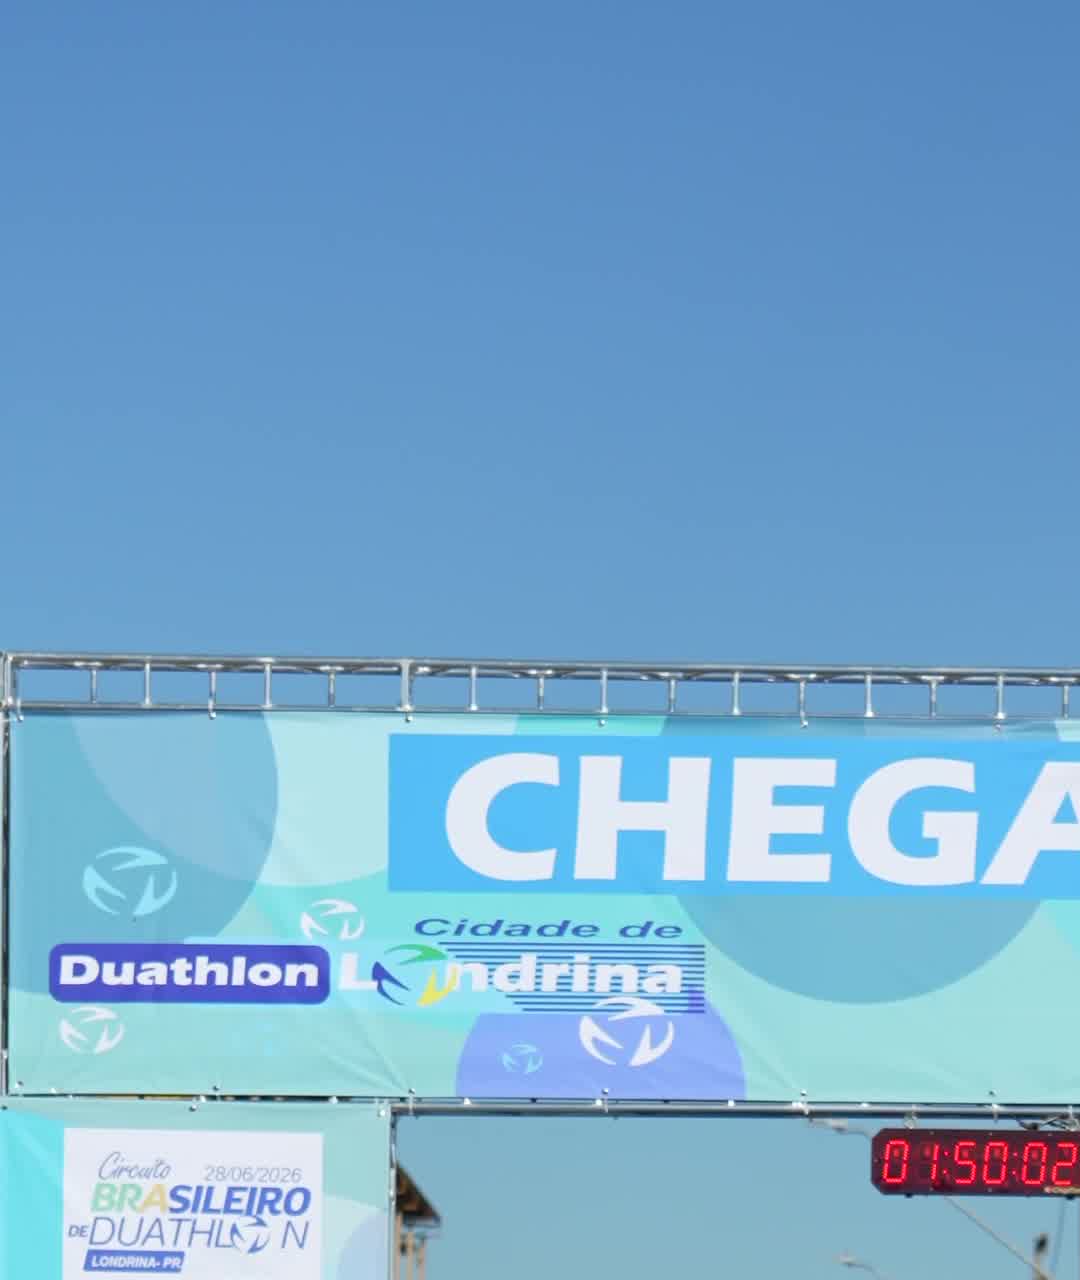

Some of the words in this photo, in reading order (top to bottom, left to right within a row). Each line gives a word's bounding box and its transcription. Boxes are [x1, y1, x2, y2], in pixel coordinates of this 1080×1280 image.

[414, 917, 600, 938] Cidade
[619, 920, 683, 940] de
[59, 954, 319, 988] Duathlon
[98, 1151, 172, 1182] Circuito
[204, 1165, 302, 1183] 28/06/2026
[882, 1138, 1079, 1185] 01:50:02
[90, 1183, 312, 1217] BRASILEIRO
[68, 1225, 89, 1238] DE
